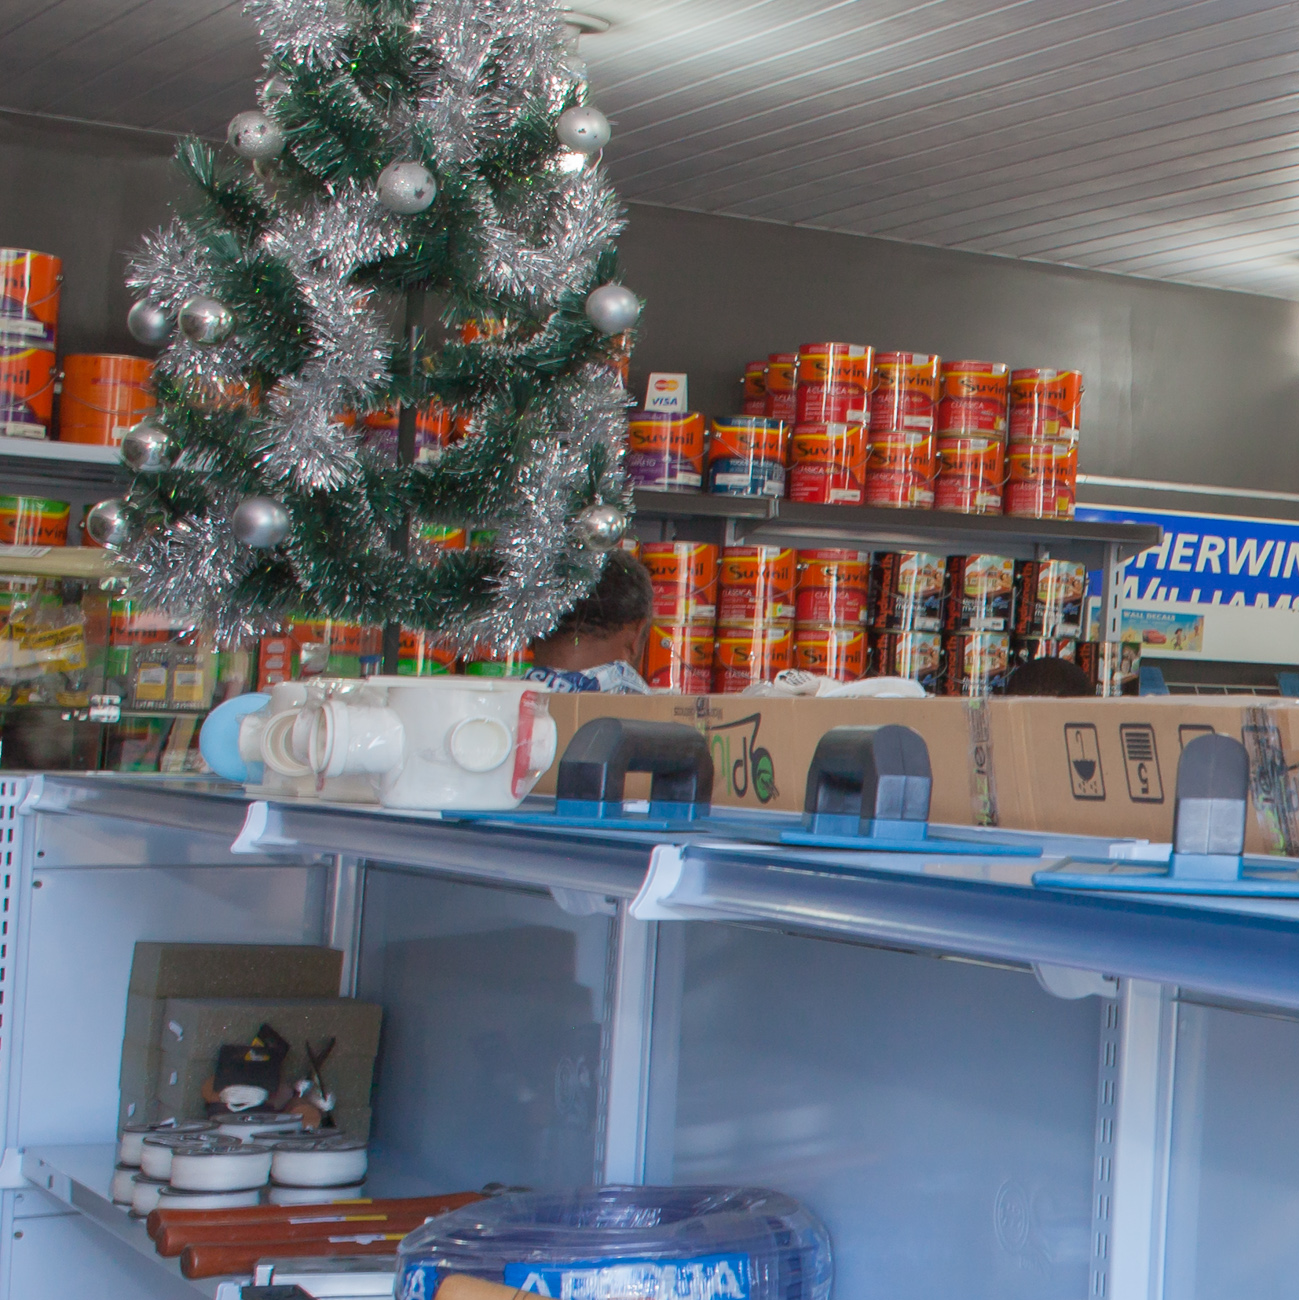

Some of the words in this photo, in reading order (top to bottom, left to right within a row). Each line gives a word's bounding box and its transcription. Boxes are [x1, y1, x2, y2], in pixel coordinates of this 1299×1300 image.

[651, 397, 679, 406] VISA
[632, 431, 694, 446] Suvinil
[796, 442, 855, 458] Suvinil
[728, 563, 789, 581] Suvinil
